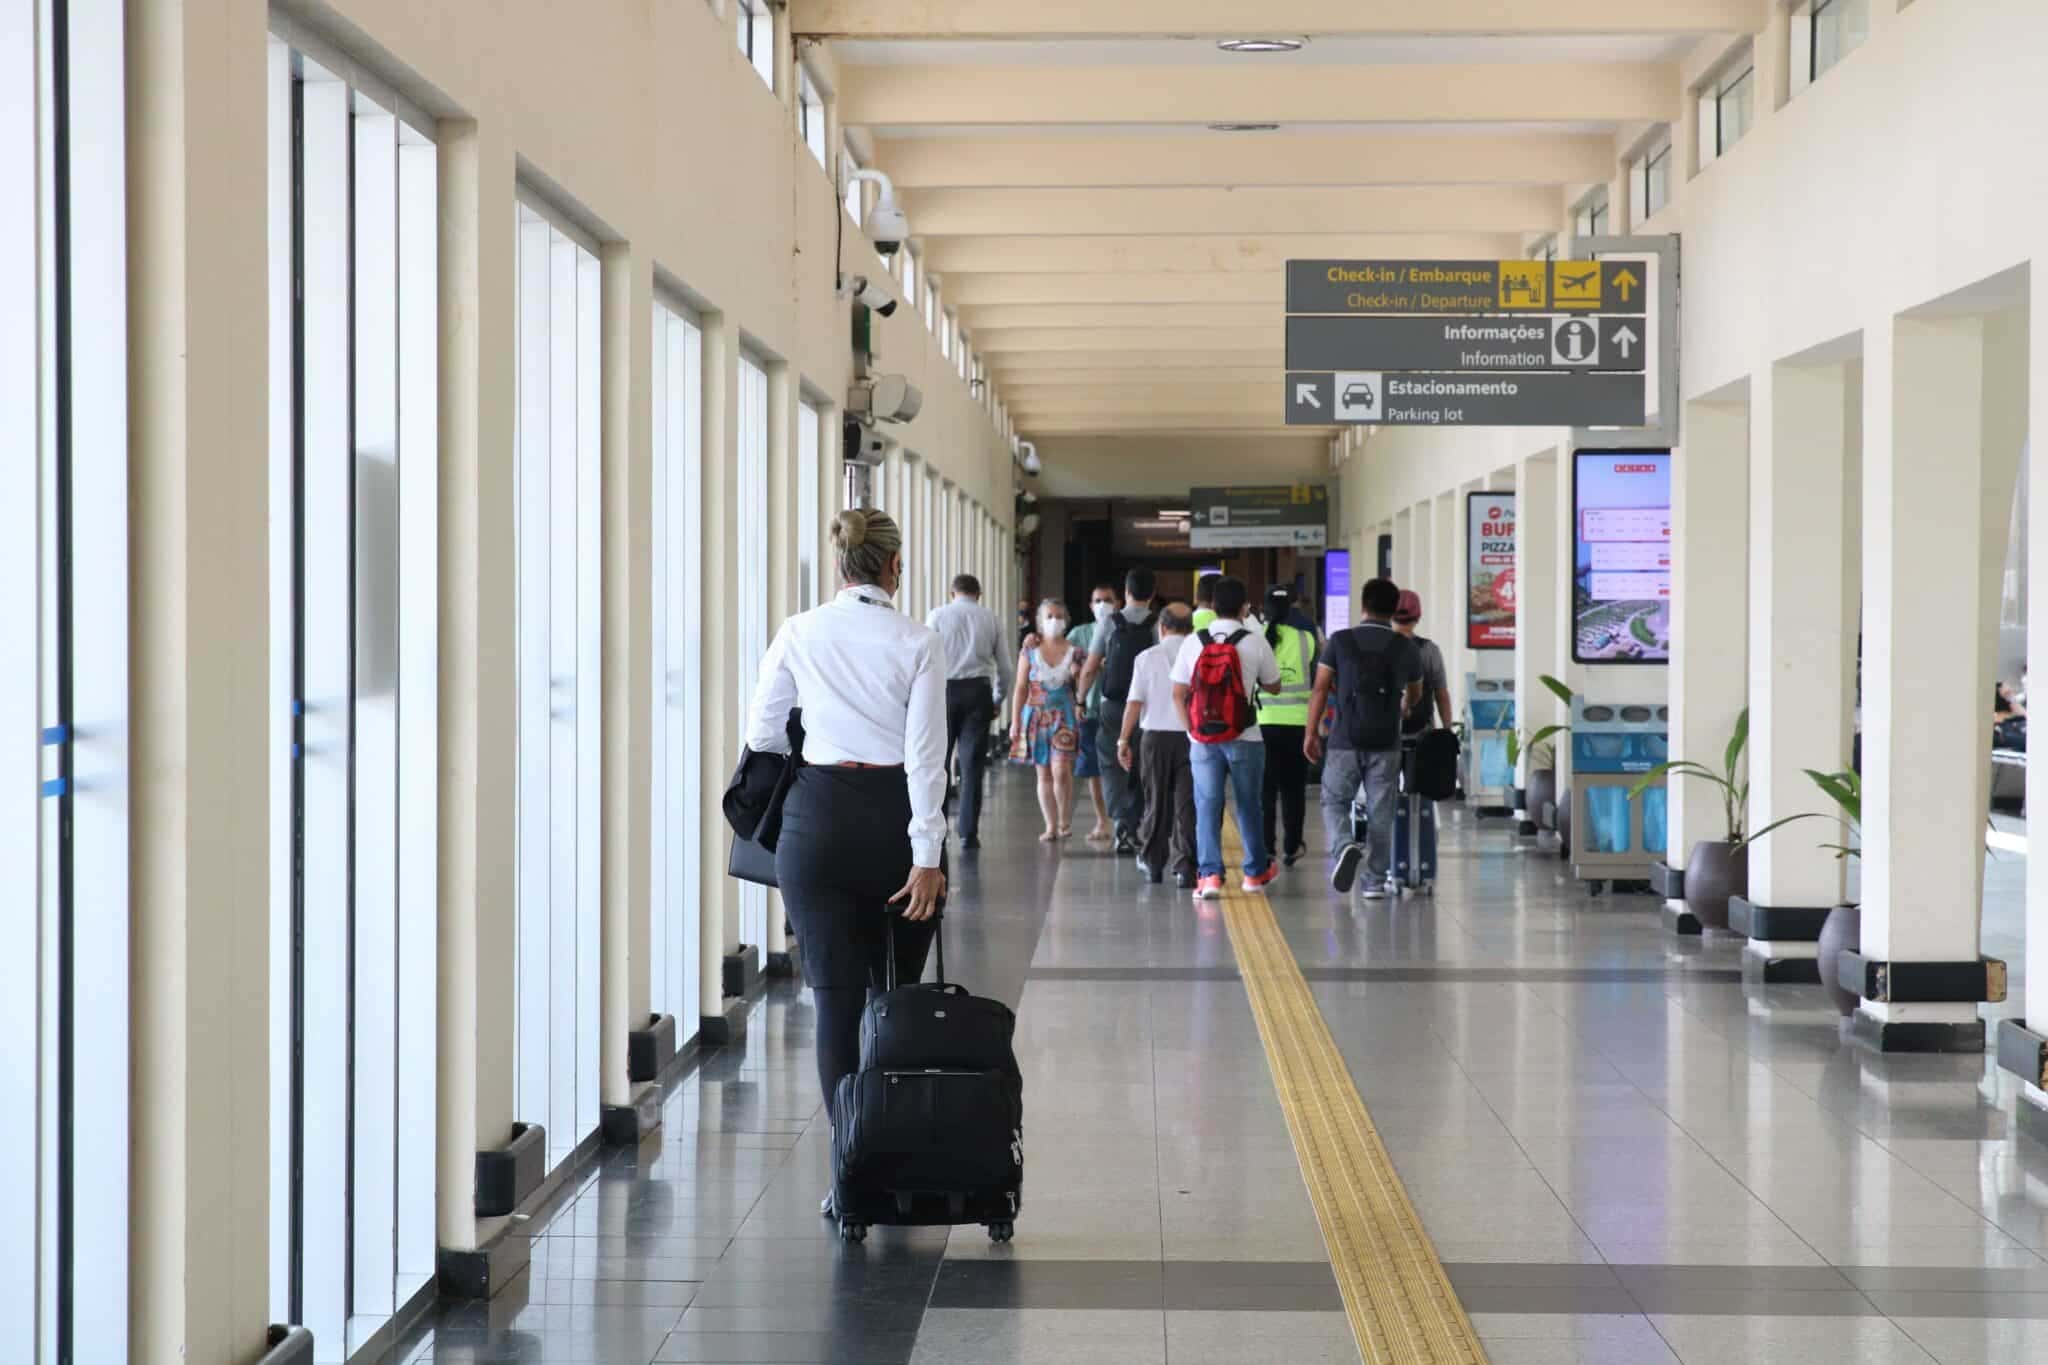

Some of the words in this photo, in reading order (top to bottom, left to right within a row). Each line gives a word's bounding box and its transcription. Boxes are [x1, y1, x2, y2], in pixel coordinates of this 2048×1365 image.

[1327, 266, 1395, 282] Check-in
[1399, 267, 1406, 284] /
[1409, 267, 1492, 286] Embarque
[1347, 293, 1408, 308] Check-in
[1411, 293, 1418, 310] /
[1421, 294, 1492, 311] Departure
[1444, 324, 1545, 344] Informações
[1461, 350, 1545, 366] Information
[1388, 380, 1518, 395] Estacionamento
[1388, 407, 1440, 424] Parking
[1444, 407, 1464, 421] lot
